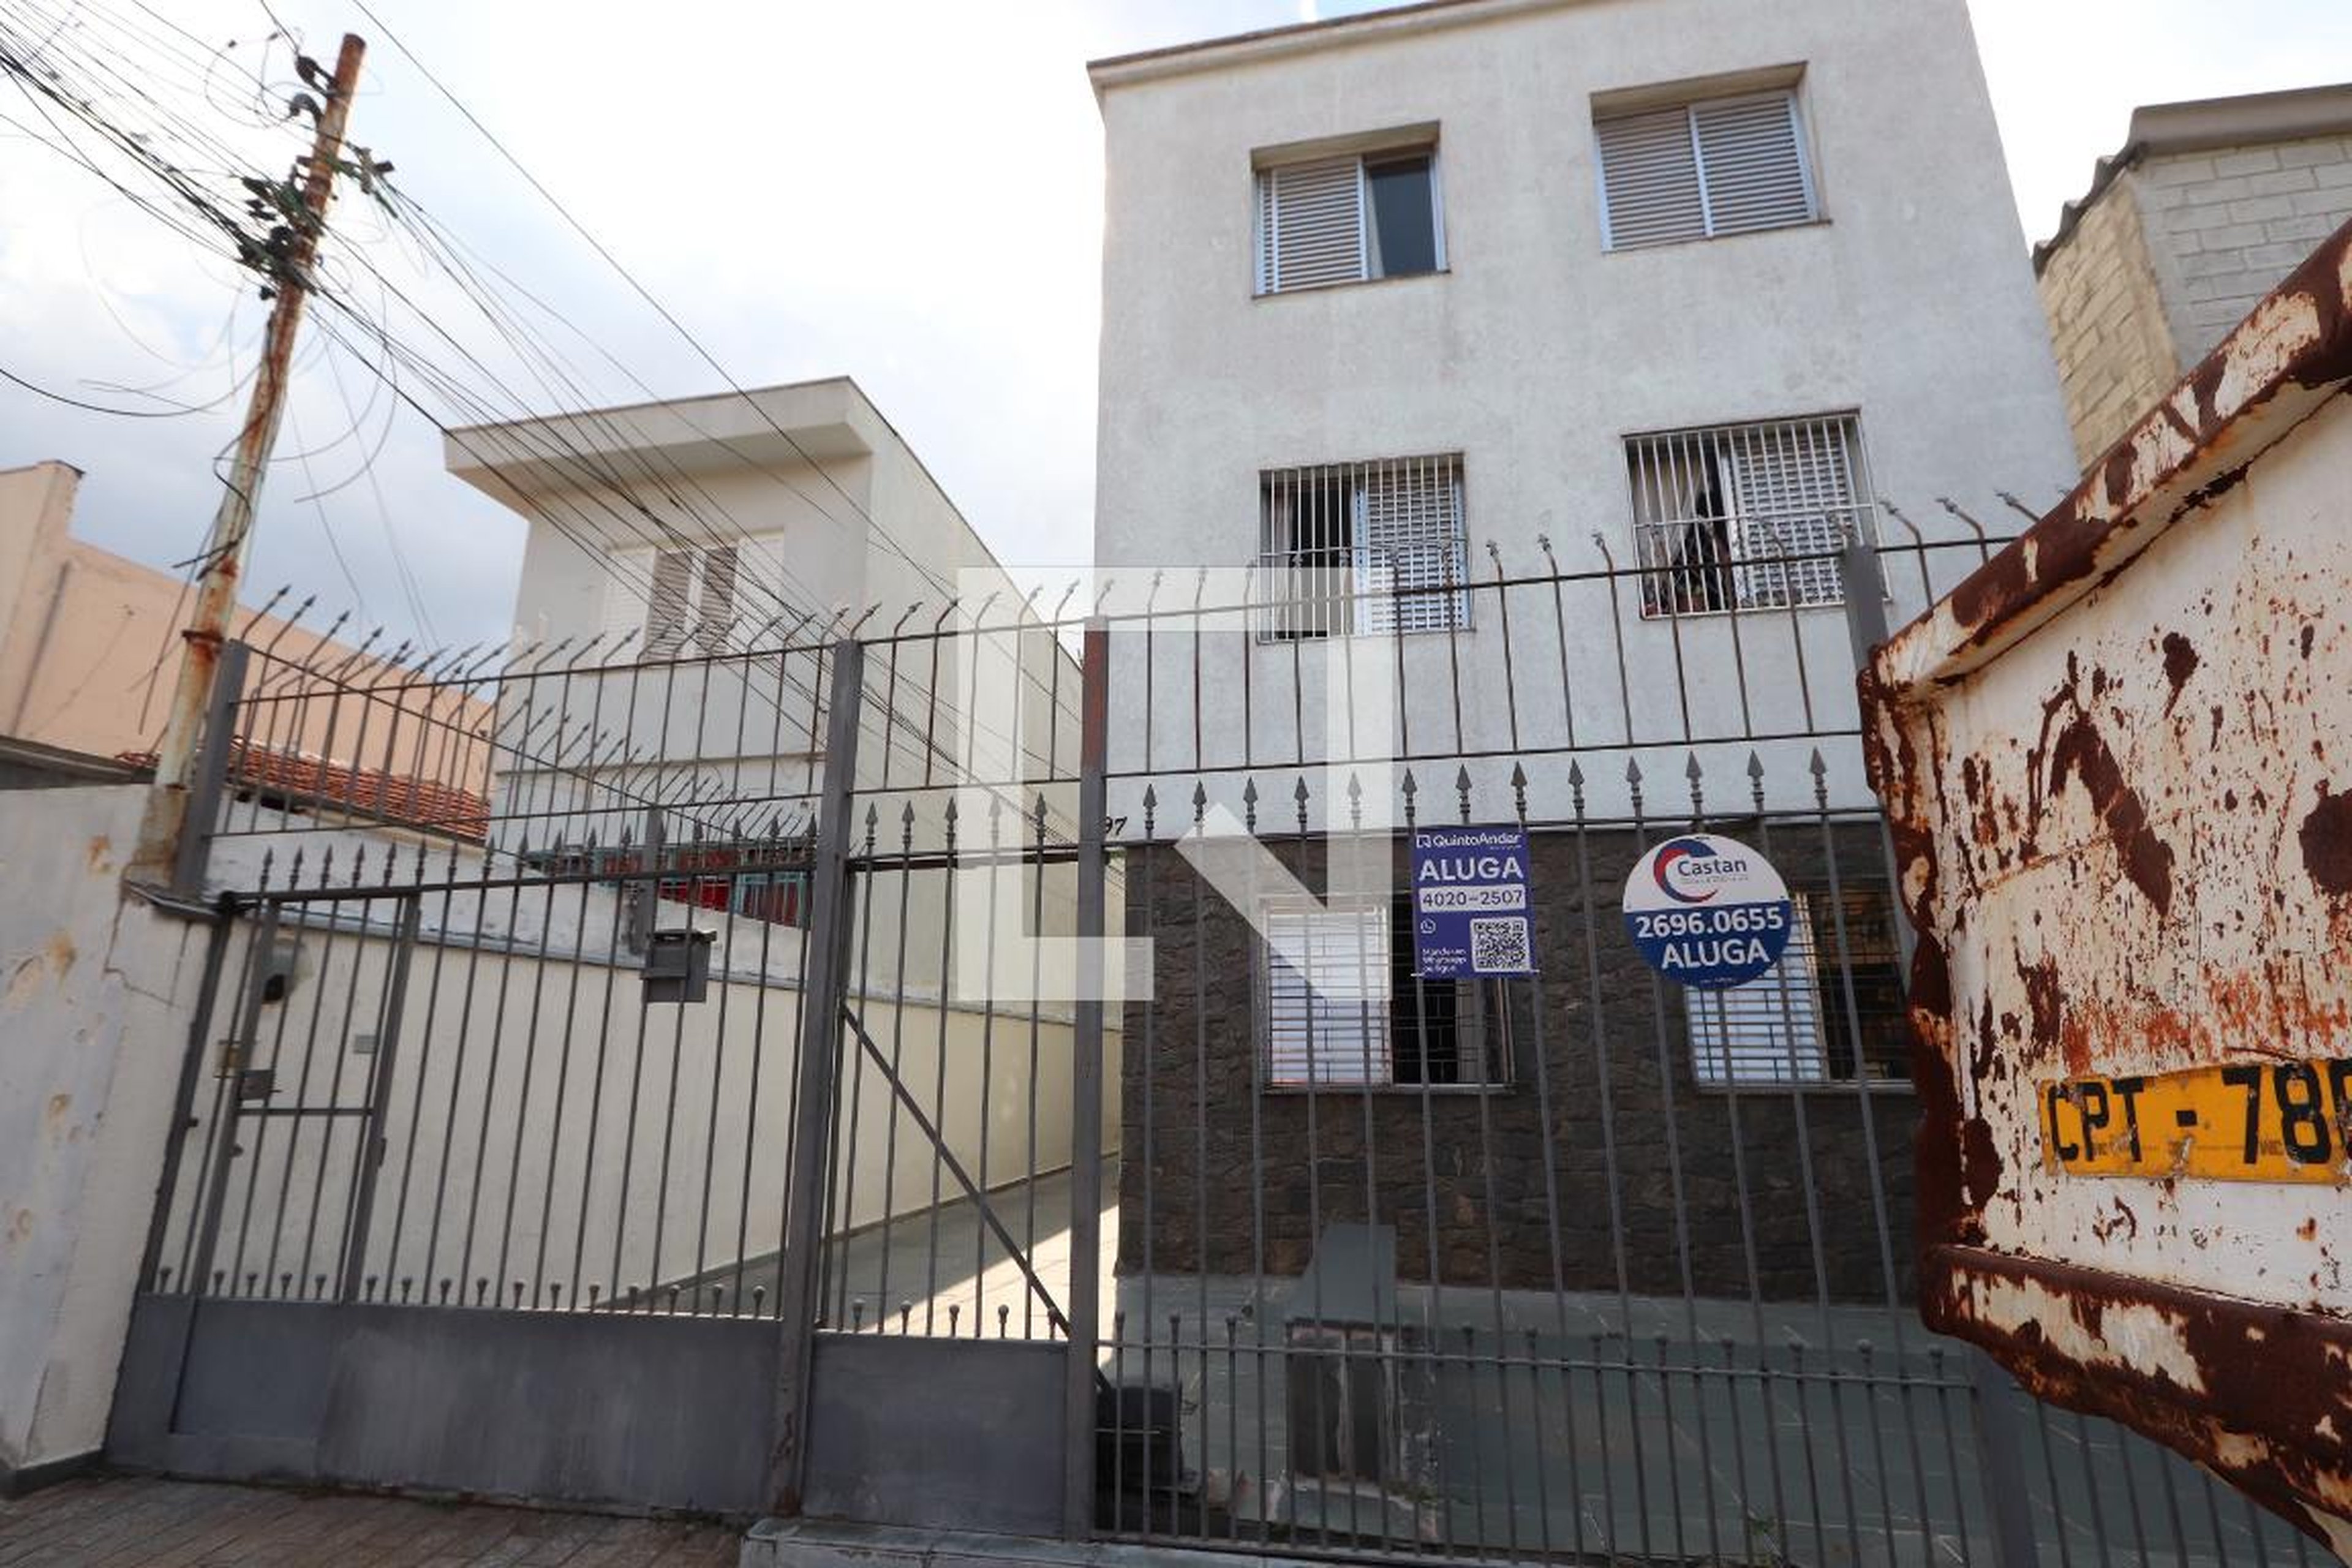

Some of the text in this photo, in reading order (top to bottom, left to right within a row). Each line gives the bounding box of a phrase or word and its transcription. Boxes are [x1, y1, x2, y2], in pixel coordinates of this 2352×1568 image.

[1433, 832, 1522, 847] QuintoAndar
[1419, 857, 1524, 881] ALUGA
[1678, 858, 1747, 876] Castan
[1423, 890, 1522, 907] 4020-2507
[1635, 907, 1783, 938] 2696.0655
[1661, 938, 1771, 969] ALUGA
